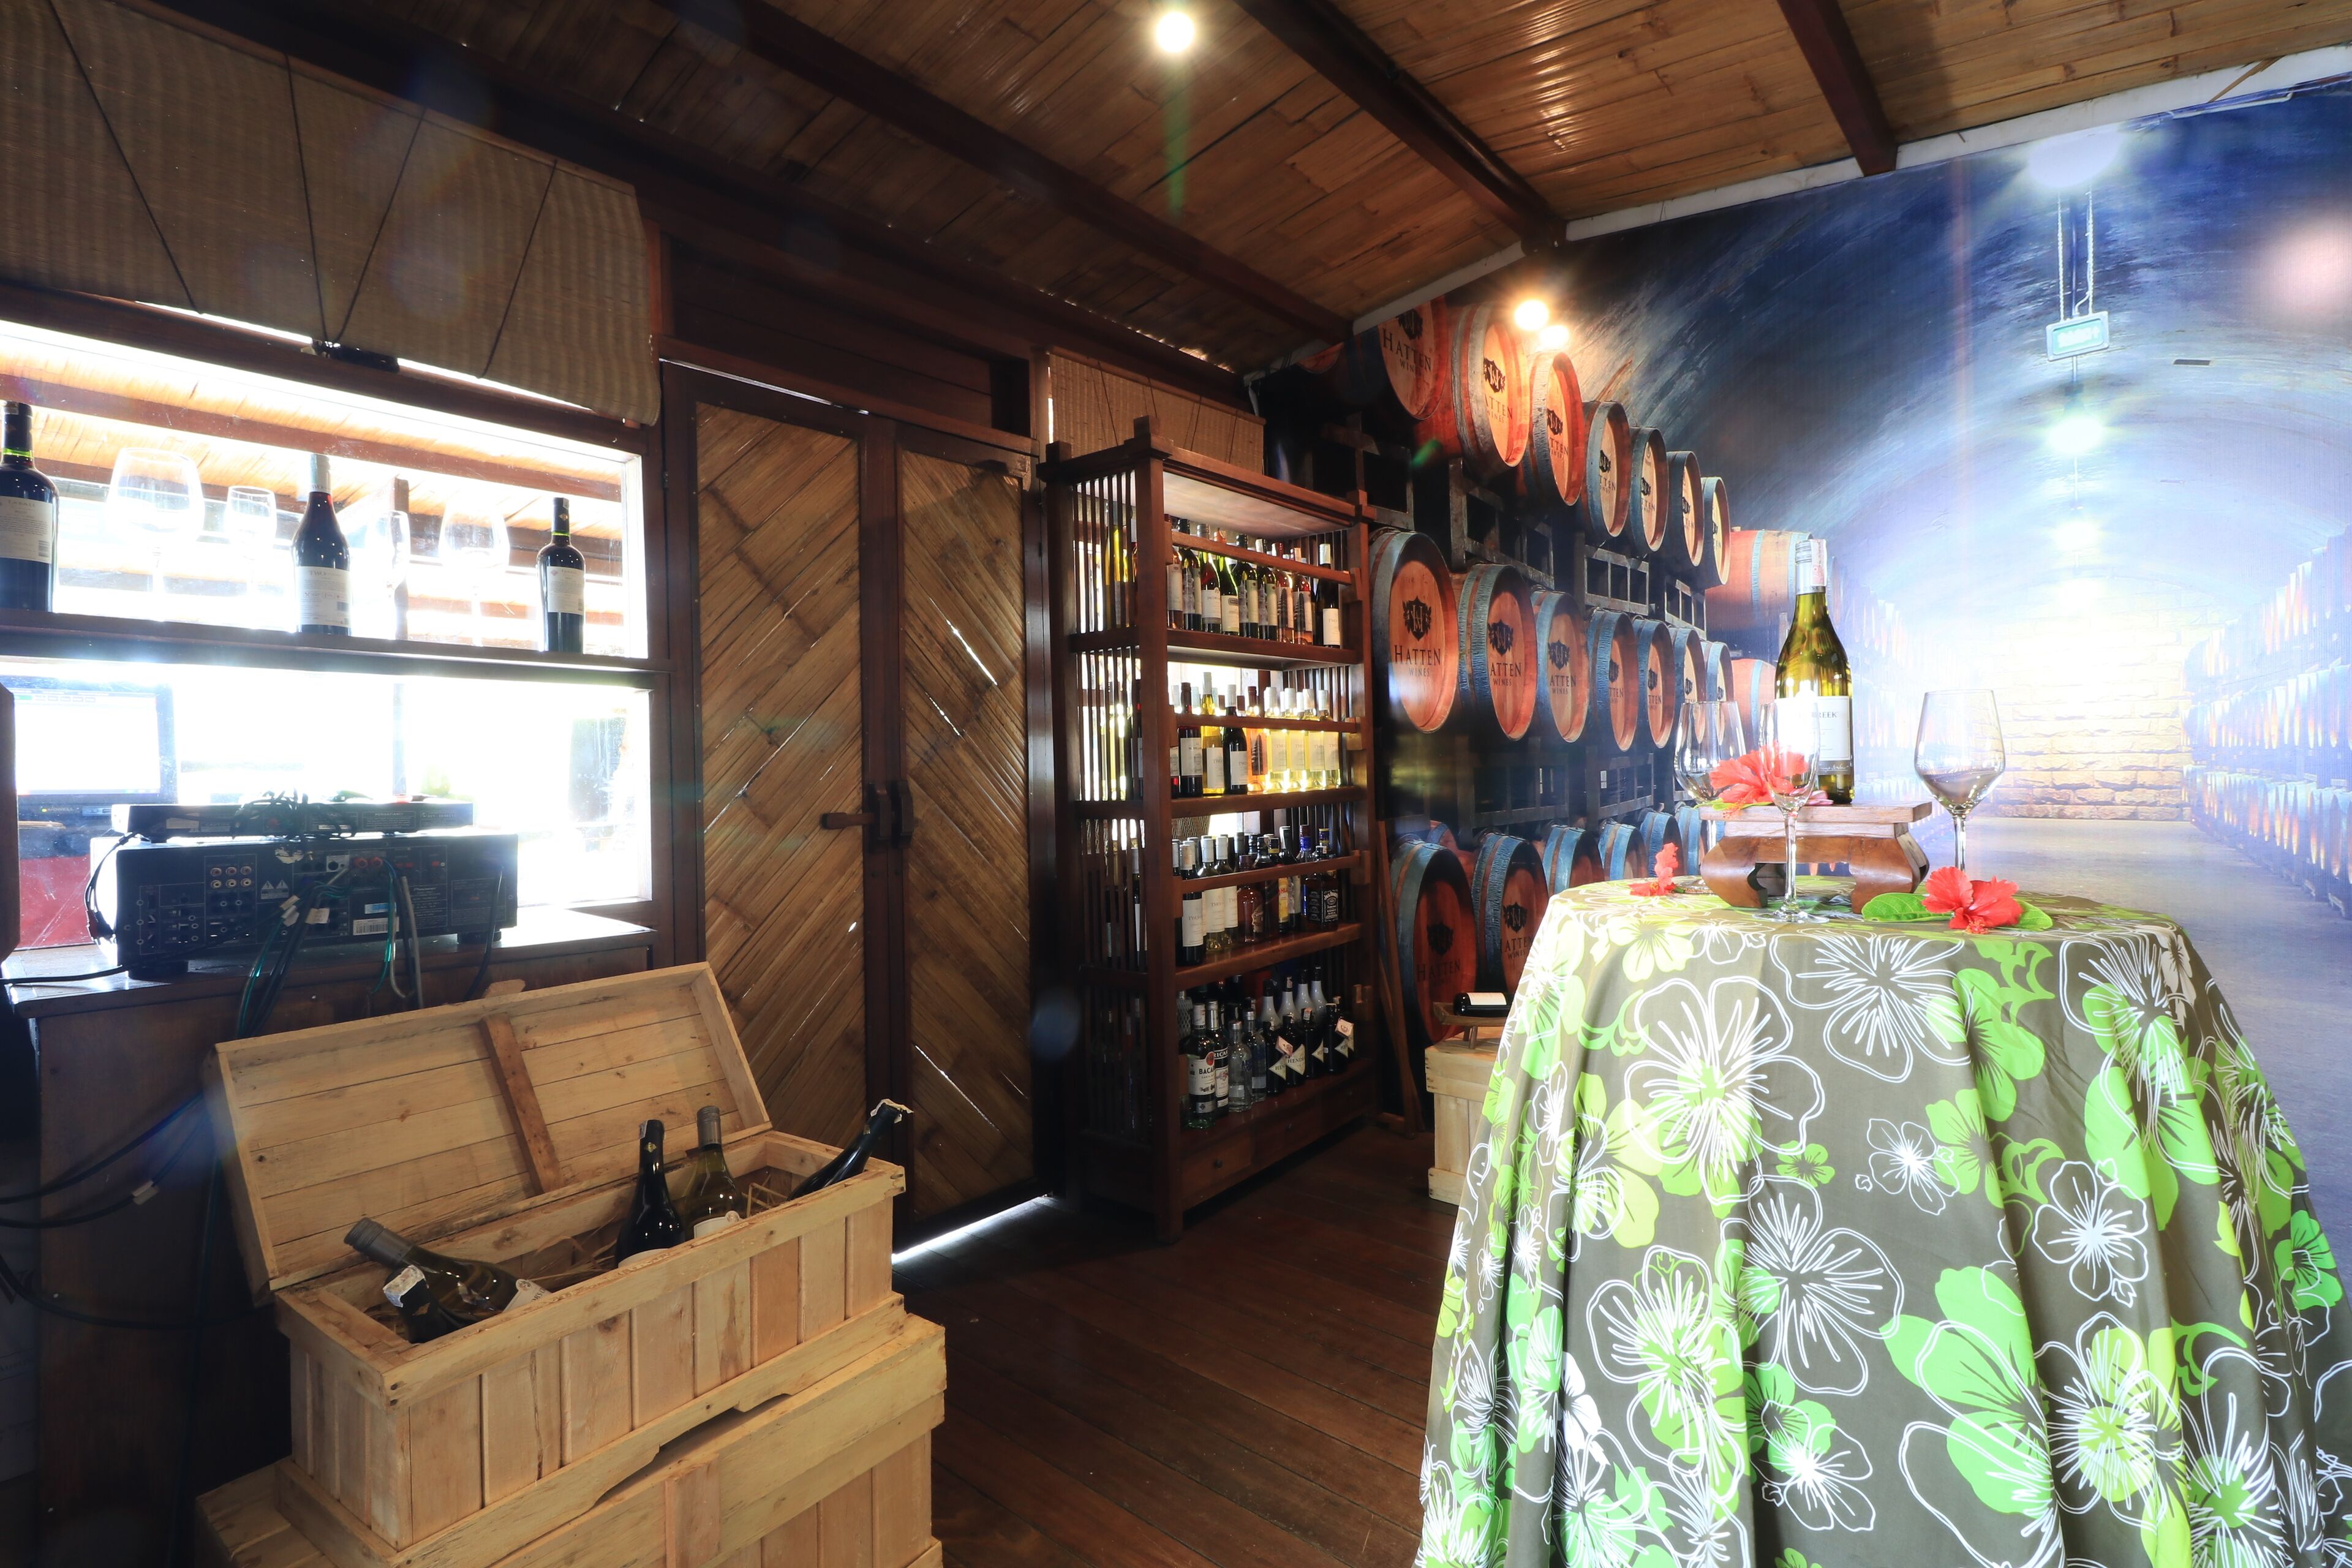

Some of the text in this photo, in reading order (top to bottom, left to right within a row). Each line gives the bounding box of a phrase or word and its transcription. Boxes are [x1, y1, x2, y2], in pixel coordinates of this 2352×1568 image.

[1393, 644, 1441, 666] HATTEN
[1409, 667, 1431, 677] WINES
[1490, 662, 1522, 677] ATTEN
[1493, 677, 1512, 687] WINES
[1550, 674, 1577, 687] ATTEN
